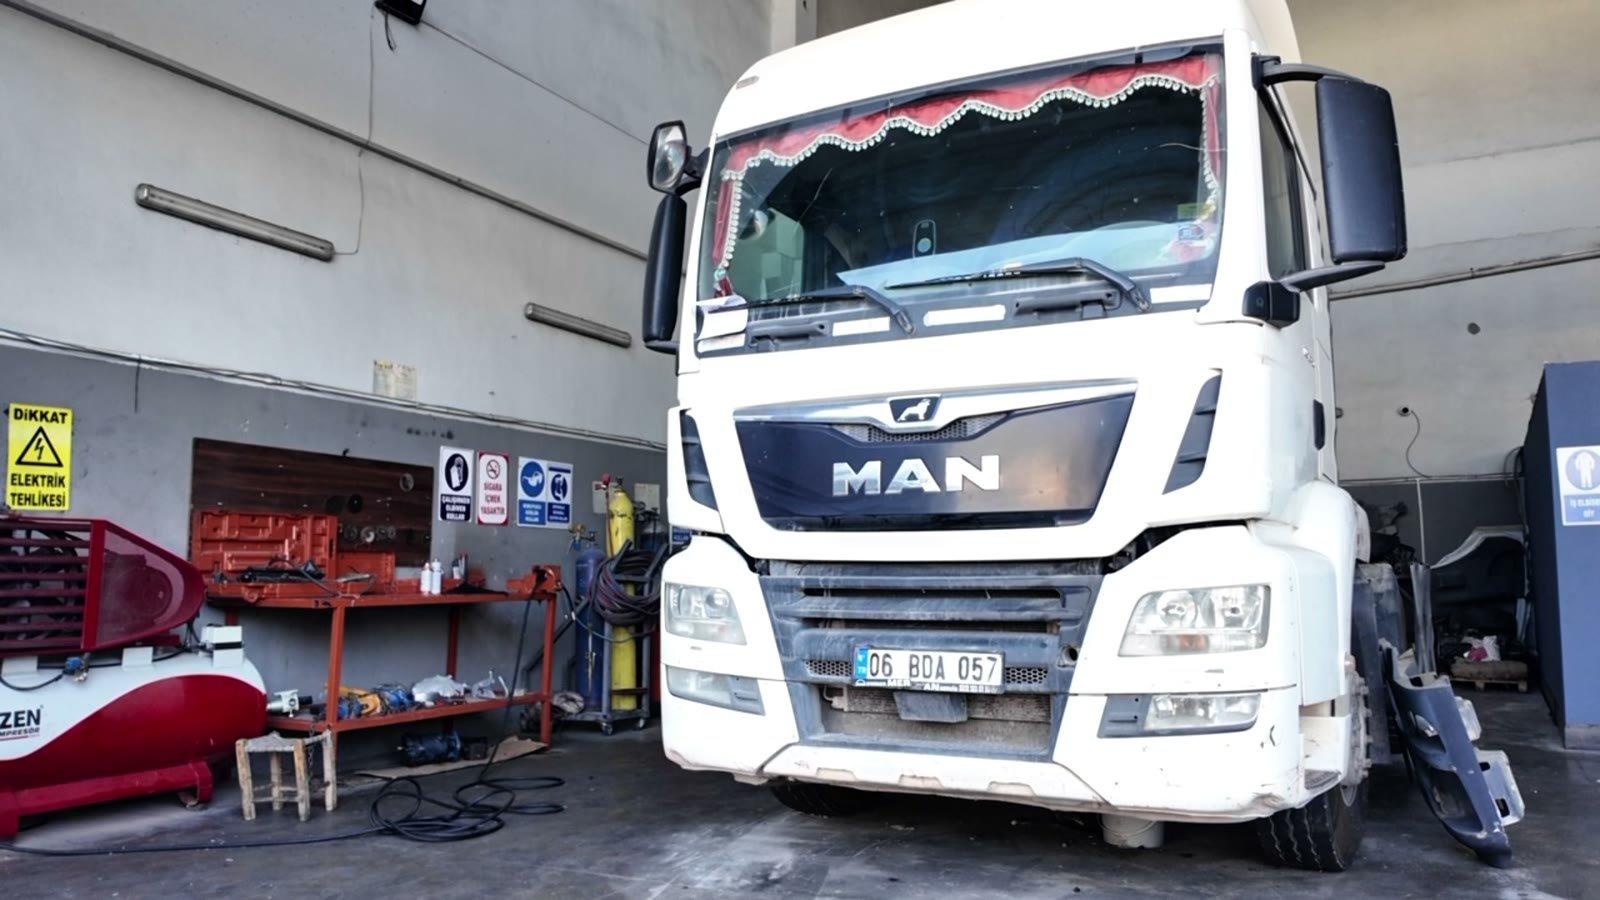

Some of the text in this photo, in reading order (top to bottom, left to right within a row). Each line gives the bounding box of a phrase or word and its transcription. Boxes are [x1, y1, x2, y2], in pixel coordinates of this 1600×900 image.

[10, 472, 66, 488] ELEKTRİK
[832, 455, 1000, 497] MAN
[10, 490, 66, 507] TEHLİKESİ
[869, 653, 997, 682] 06 BDA 057
